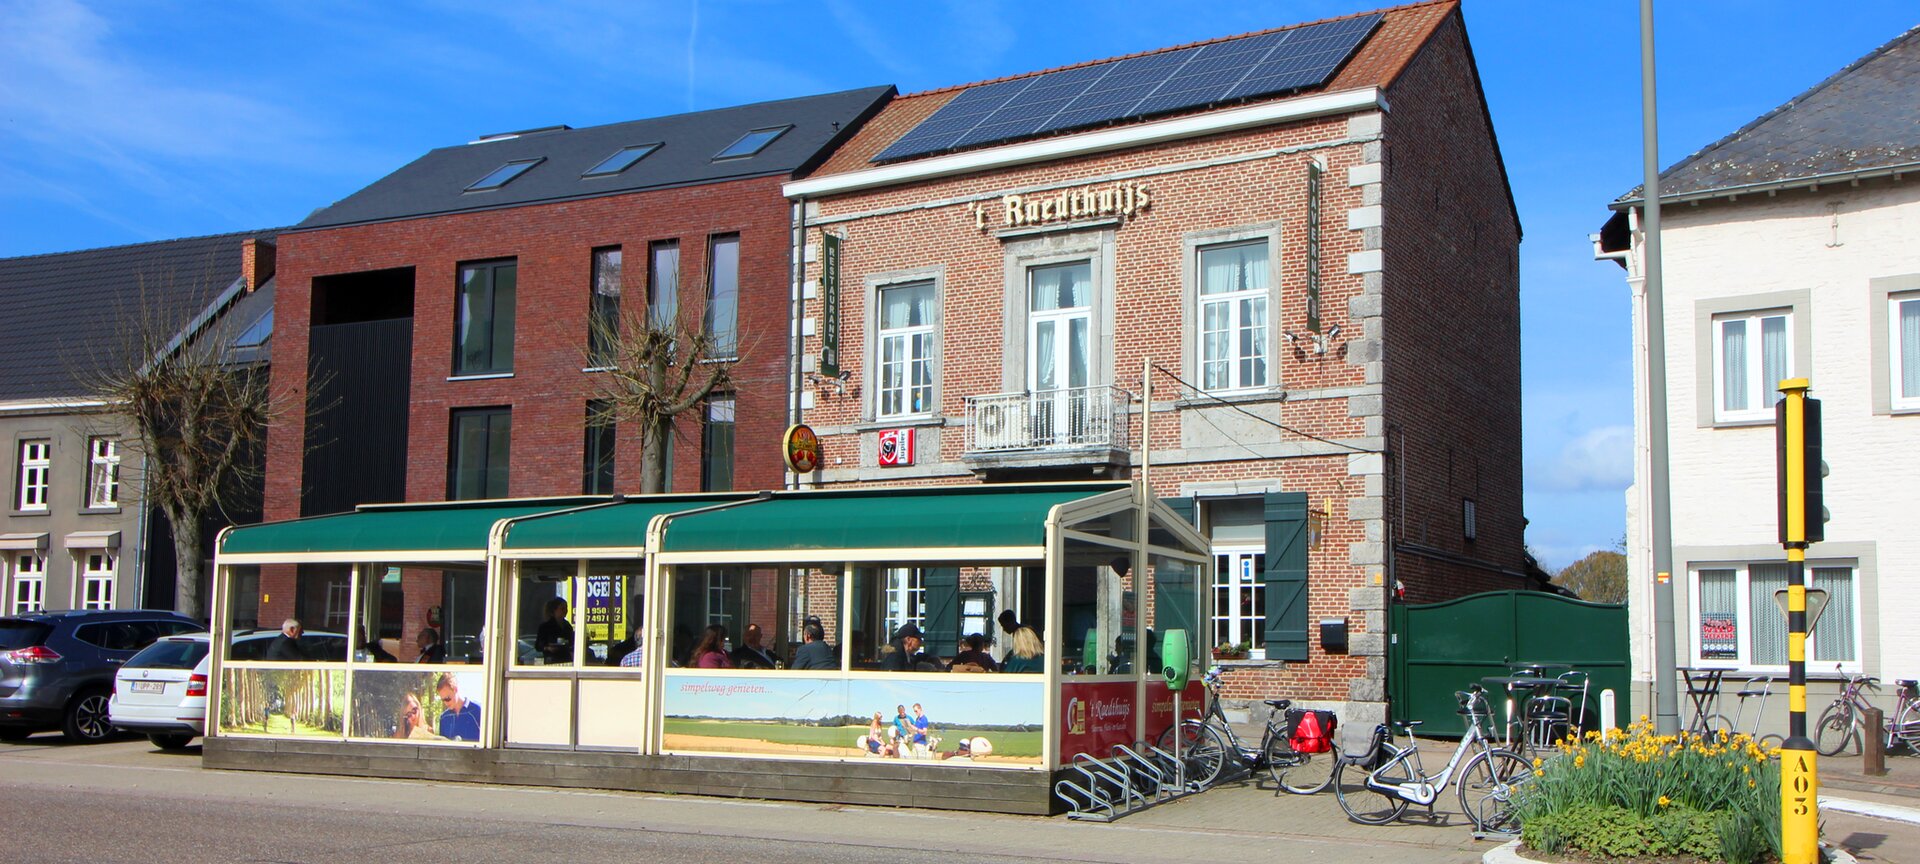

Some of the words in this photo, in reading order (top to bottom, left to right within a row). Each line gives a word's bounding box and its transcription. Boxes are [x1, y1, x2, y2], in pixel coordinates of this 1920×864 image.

[1003, 181, 1150, 226] Raedthuijs
[828, 247, 836, 343] RESTAURANT
[680, 680, 725, 696] simpelweg
[1096, 698, 1131, 720] Raedthuijs
[1793, 755, 1809, 816] A03
